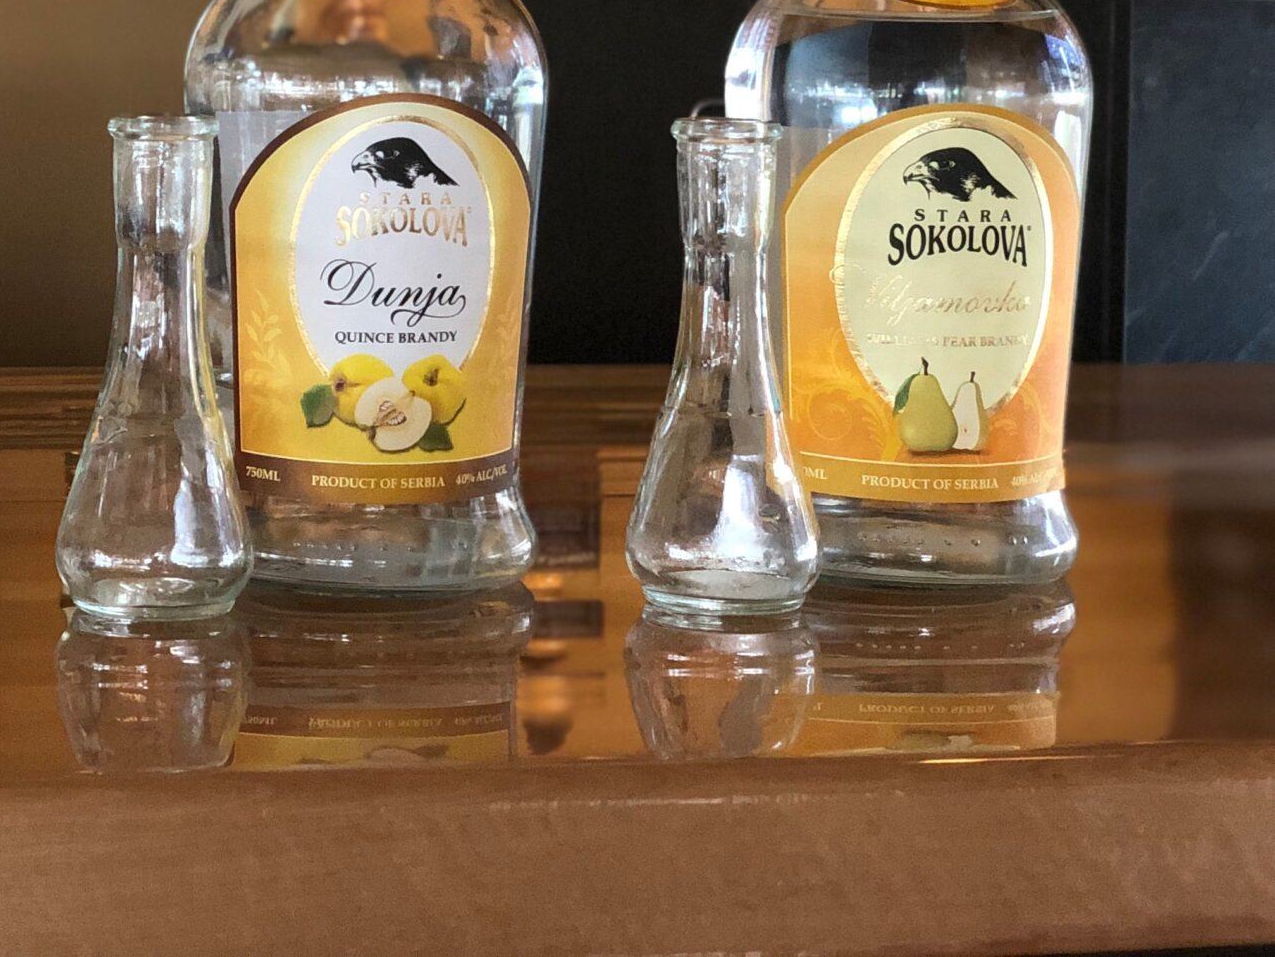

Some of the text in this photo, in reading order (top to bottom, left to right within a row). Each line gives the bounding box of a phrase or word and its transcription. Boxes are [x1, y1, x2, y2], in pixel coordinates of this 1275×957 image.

[359, 191, 453, 205] STARA
[914, 209, 1011, 222] STARA
[320, 259, 467, 327] Dunja
[335, 330, 457, 344] QUINCE BRANDY
[943, 336, 976, 347] PEAR
[245, 465, 281, 482] 750ML
[311, 475, 445, 489] PRODUCT OF SERBIA
[861, 475, 999, 490] PRODUCT OF SERBIA
